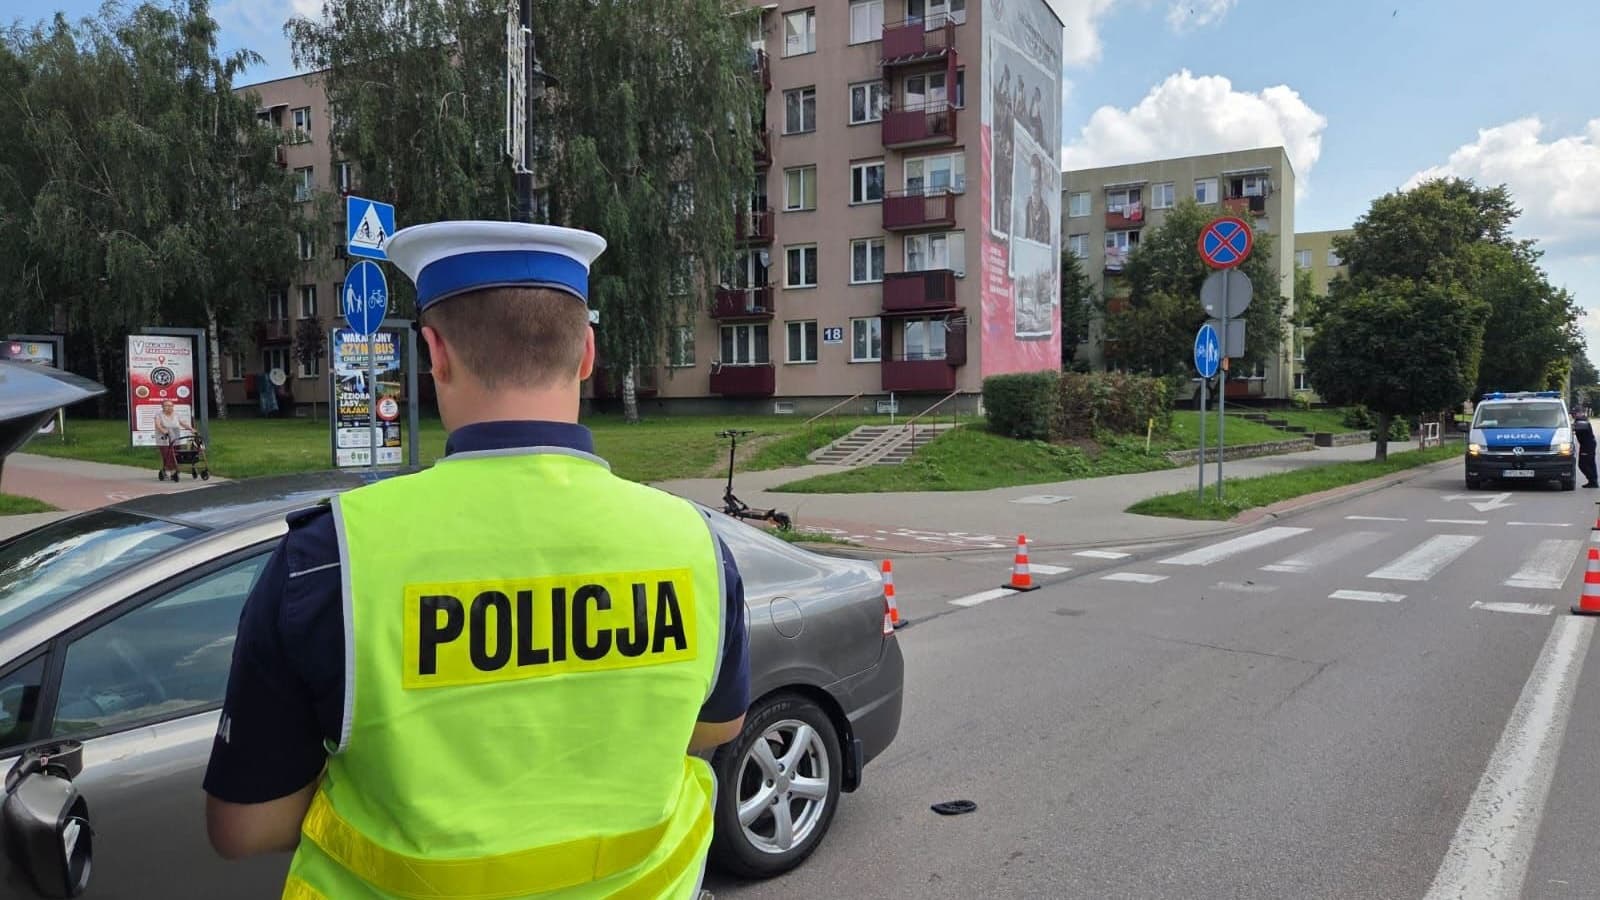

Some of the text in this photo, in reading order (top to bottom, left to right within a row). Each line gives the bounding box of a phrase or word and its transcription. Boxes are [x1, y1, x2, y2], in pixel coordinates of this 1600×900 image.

[342, 333, 391, 343] WAKAYJNY
[825, 328, 841, 340] 18
[133, 341, 144, 355] V
[341, 344, 394, 355] SZYNBUS
[418, 581, 688, 675] POLICJA
